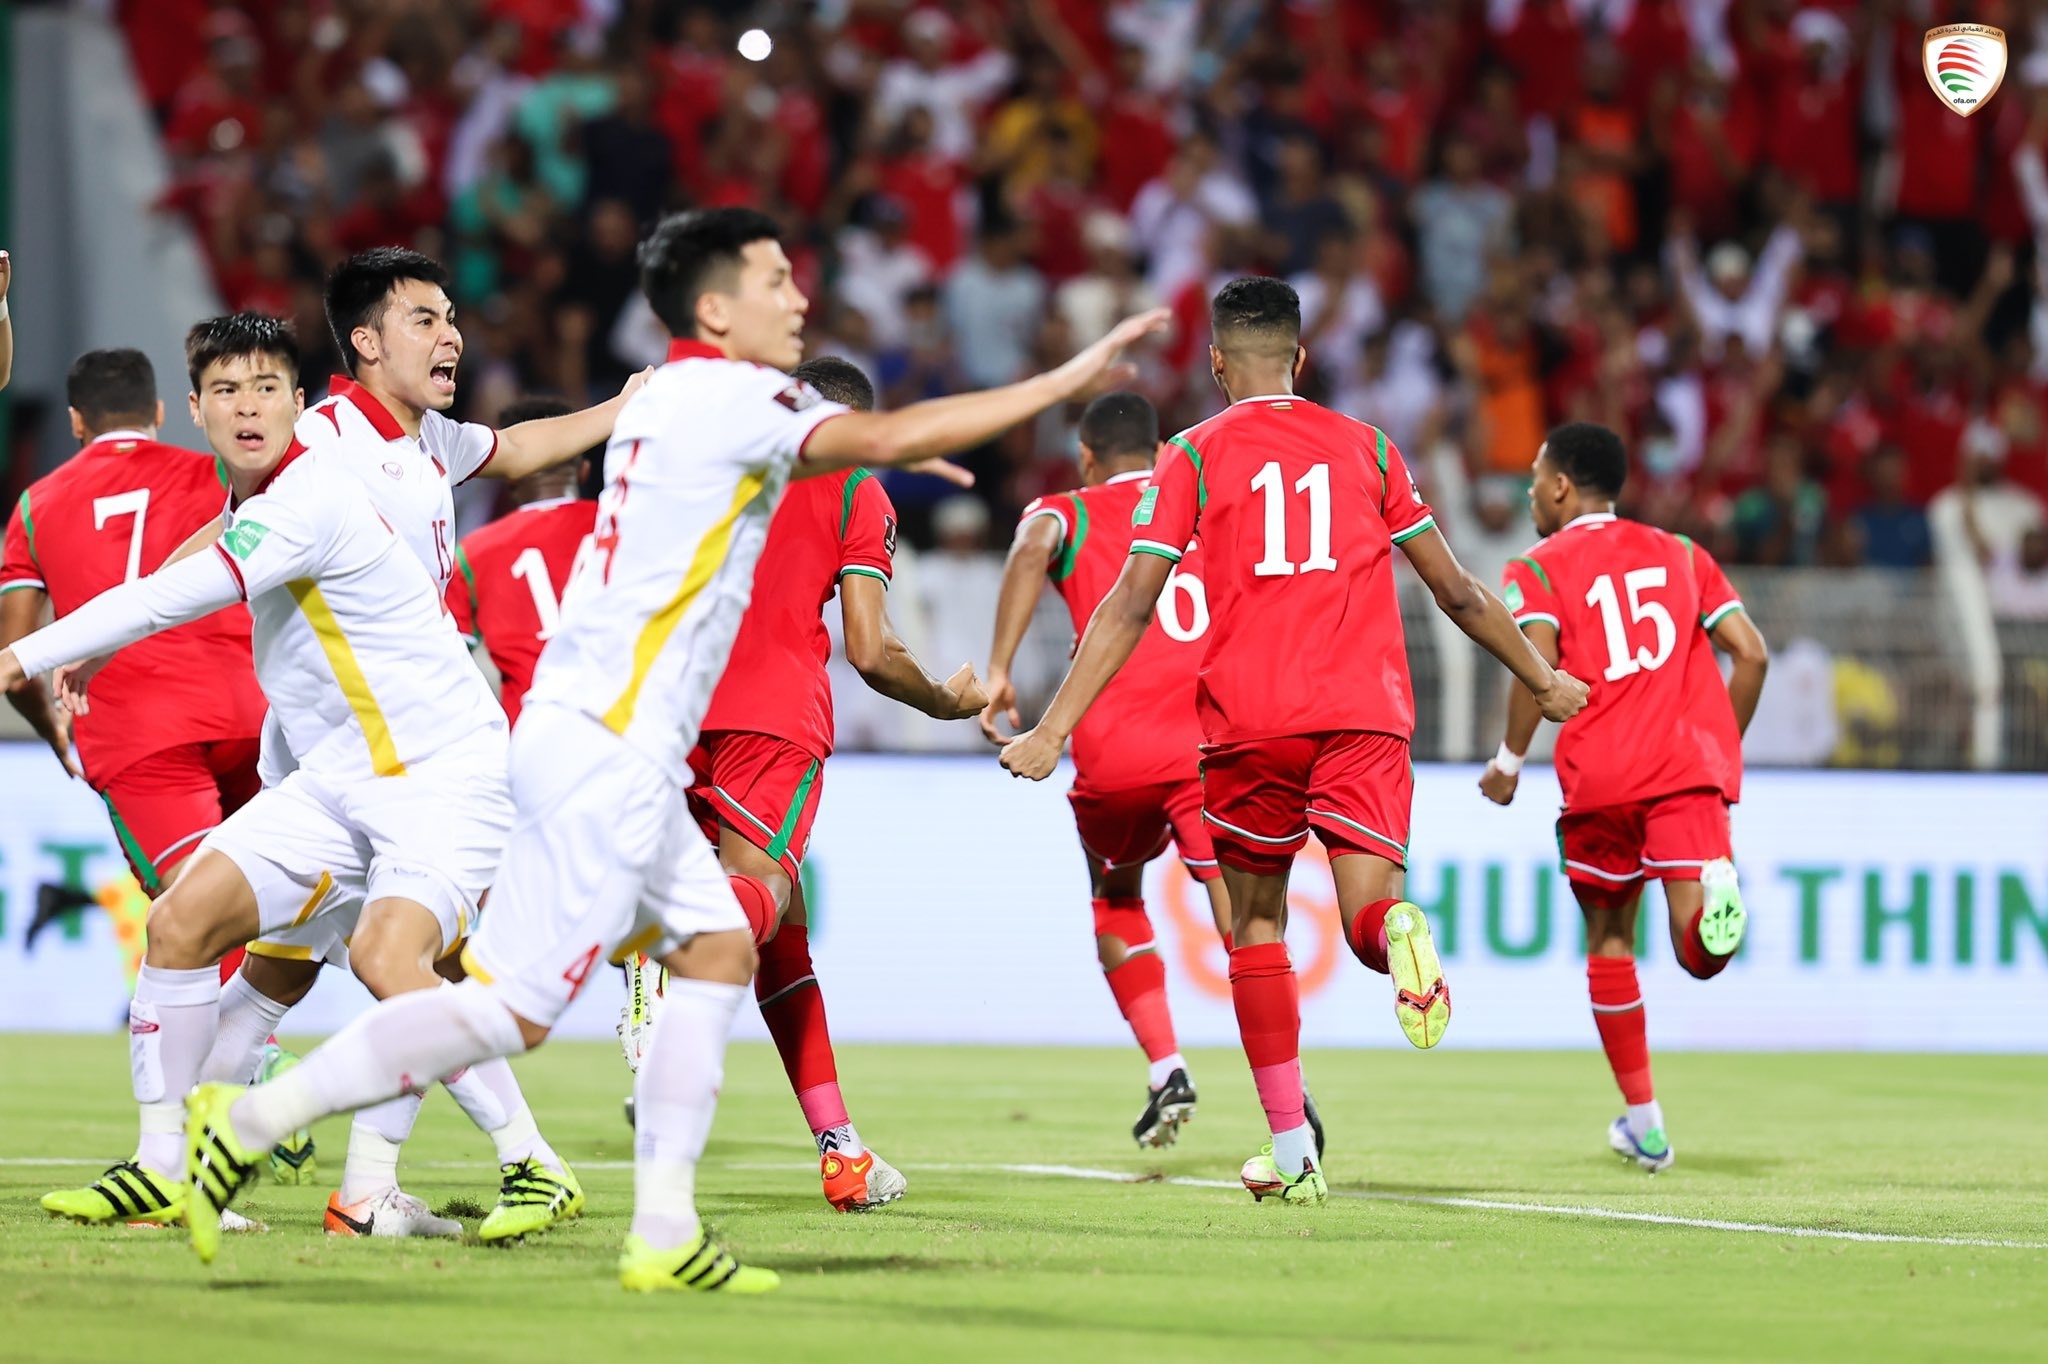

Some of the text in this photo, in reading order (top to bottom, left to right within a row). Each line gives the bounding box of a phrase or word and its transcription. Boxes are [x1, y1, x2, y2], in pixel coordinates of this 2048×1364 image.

[93, 488, 150, 583] 7
[432, 519, 452, 580] 15
[1250, 461, 1337, 576] 11
[1154, 540, 1210, 642] 6
[1585, 566, 1676, 682] 15
[563, 944, 600, 1002] 4
